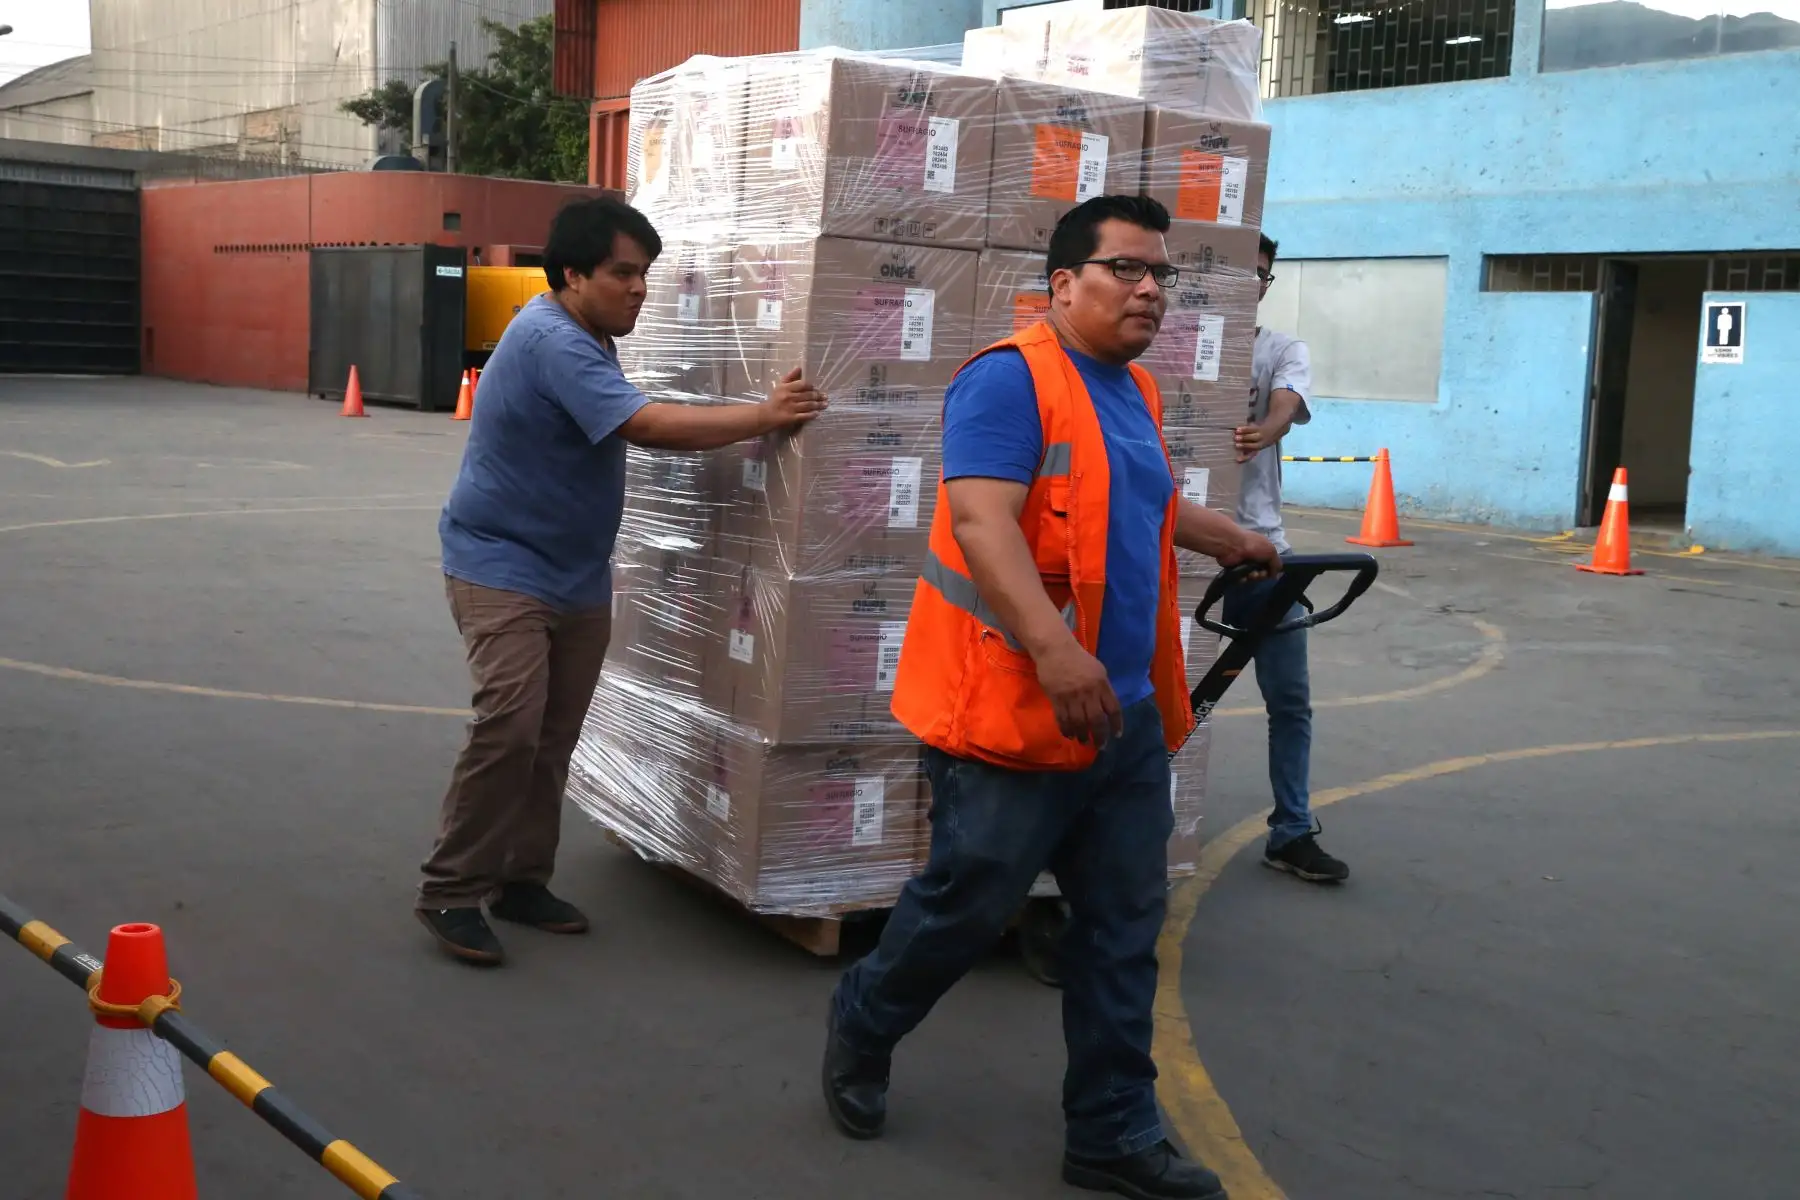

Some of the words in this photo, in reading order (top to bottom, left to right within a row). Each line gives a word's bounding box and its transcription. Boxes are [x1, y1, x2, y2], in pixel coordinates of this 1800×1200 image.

[898, 125, 936, 137] SUFRAGIO
[1200, 134, 1229, 149] ONPE
[880, 263, 916, 280] ONPE
[874, 297, 913, 308] SUFRAGIO
[863, 467, 900, 476] SUFRAGIO
